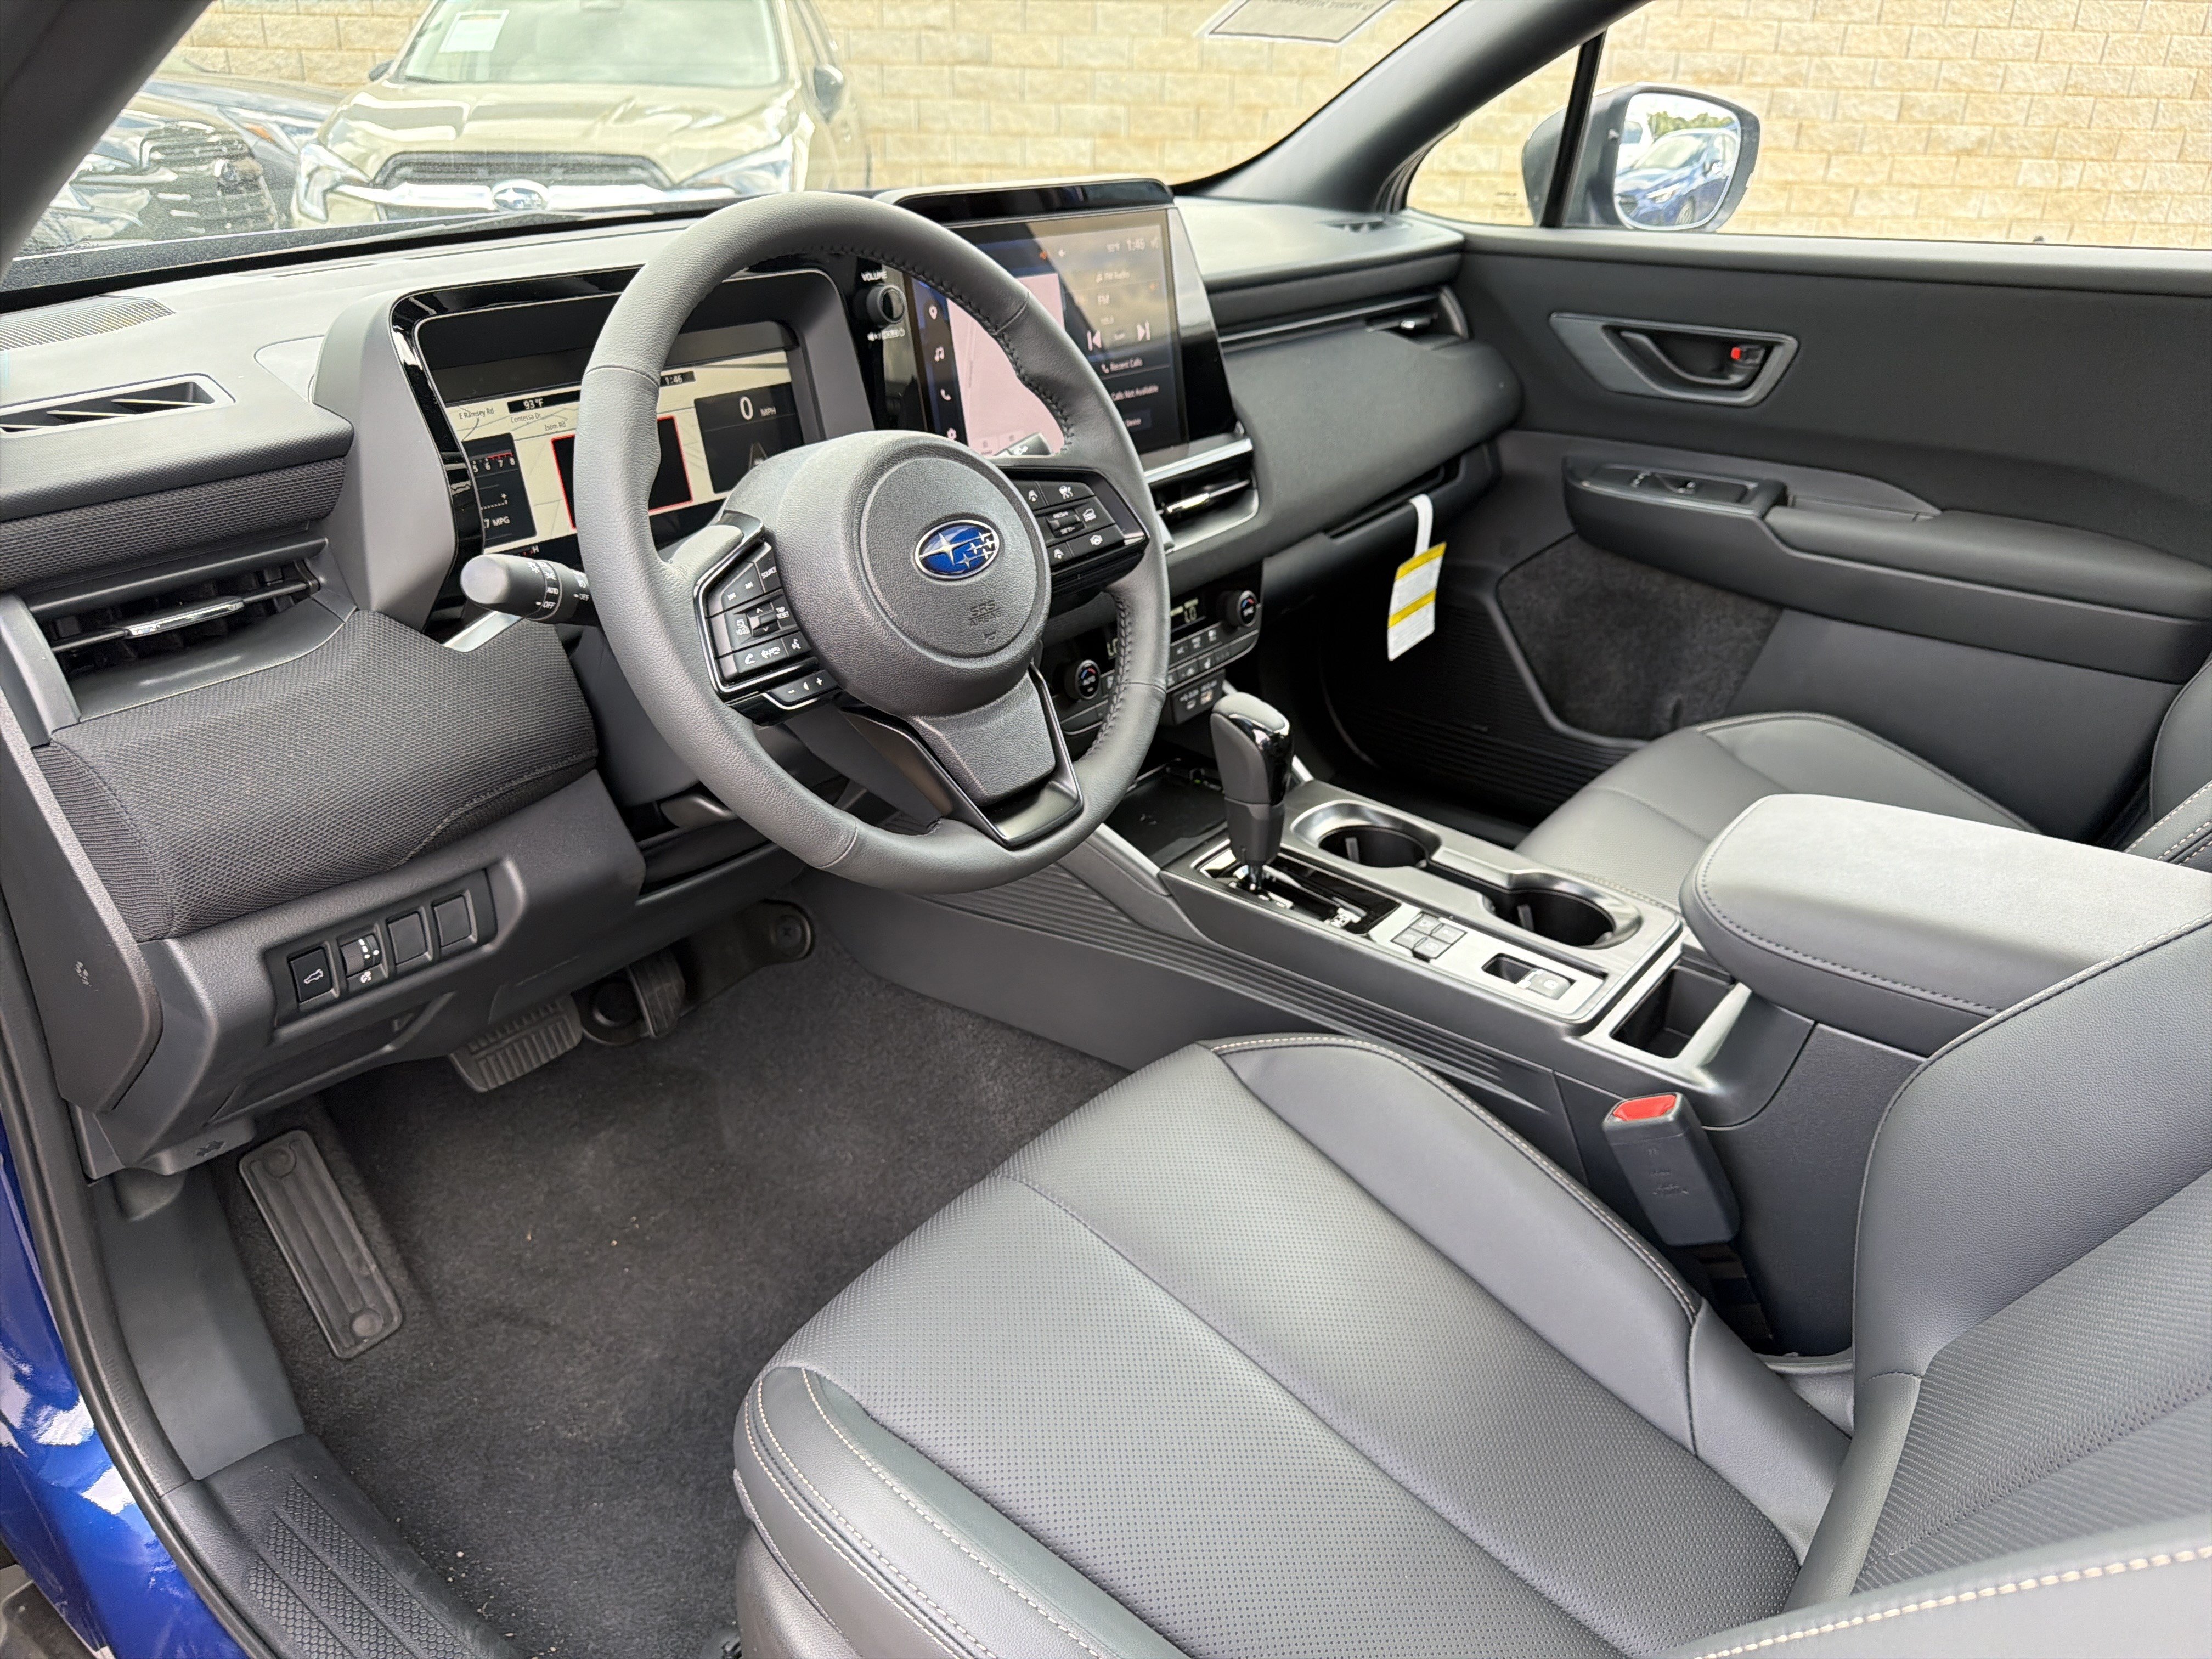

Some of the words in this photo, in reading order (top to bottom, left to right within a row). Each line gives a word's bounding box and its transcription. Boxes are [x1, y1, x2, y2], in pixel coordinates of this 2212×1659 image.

[861, 270, 888, 281] VOLUME
[740, 397, 753, 420] 0
[760, 406, 776, 416] MPH
[464, 409, 486, 419] Ramsey
[510, 414, 534, 424] Contessa
[510, 457, 516, 465] 8
[492, 516, 510, 527] MPG
[761, 566, 776, 579] SOURCE
[543, 601, 556, 609] OFF
[970, 600, 996, 616] SRS
